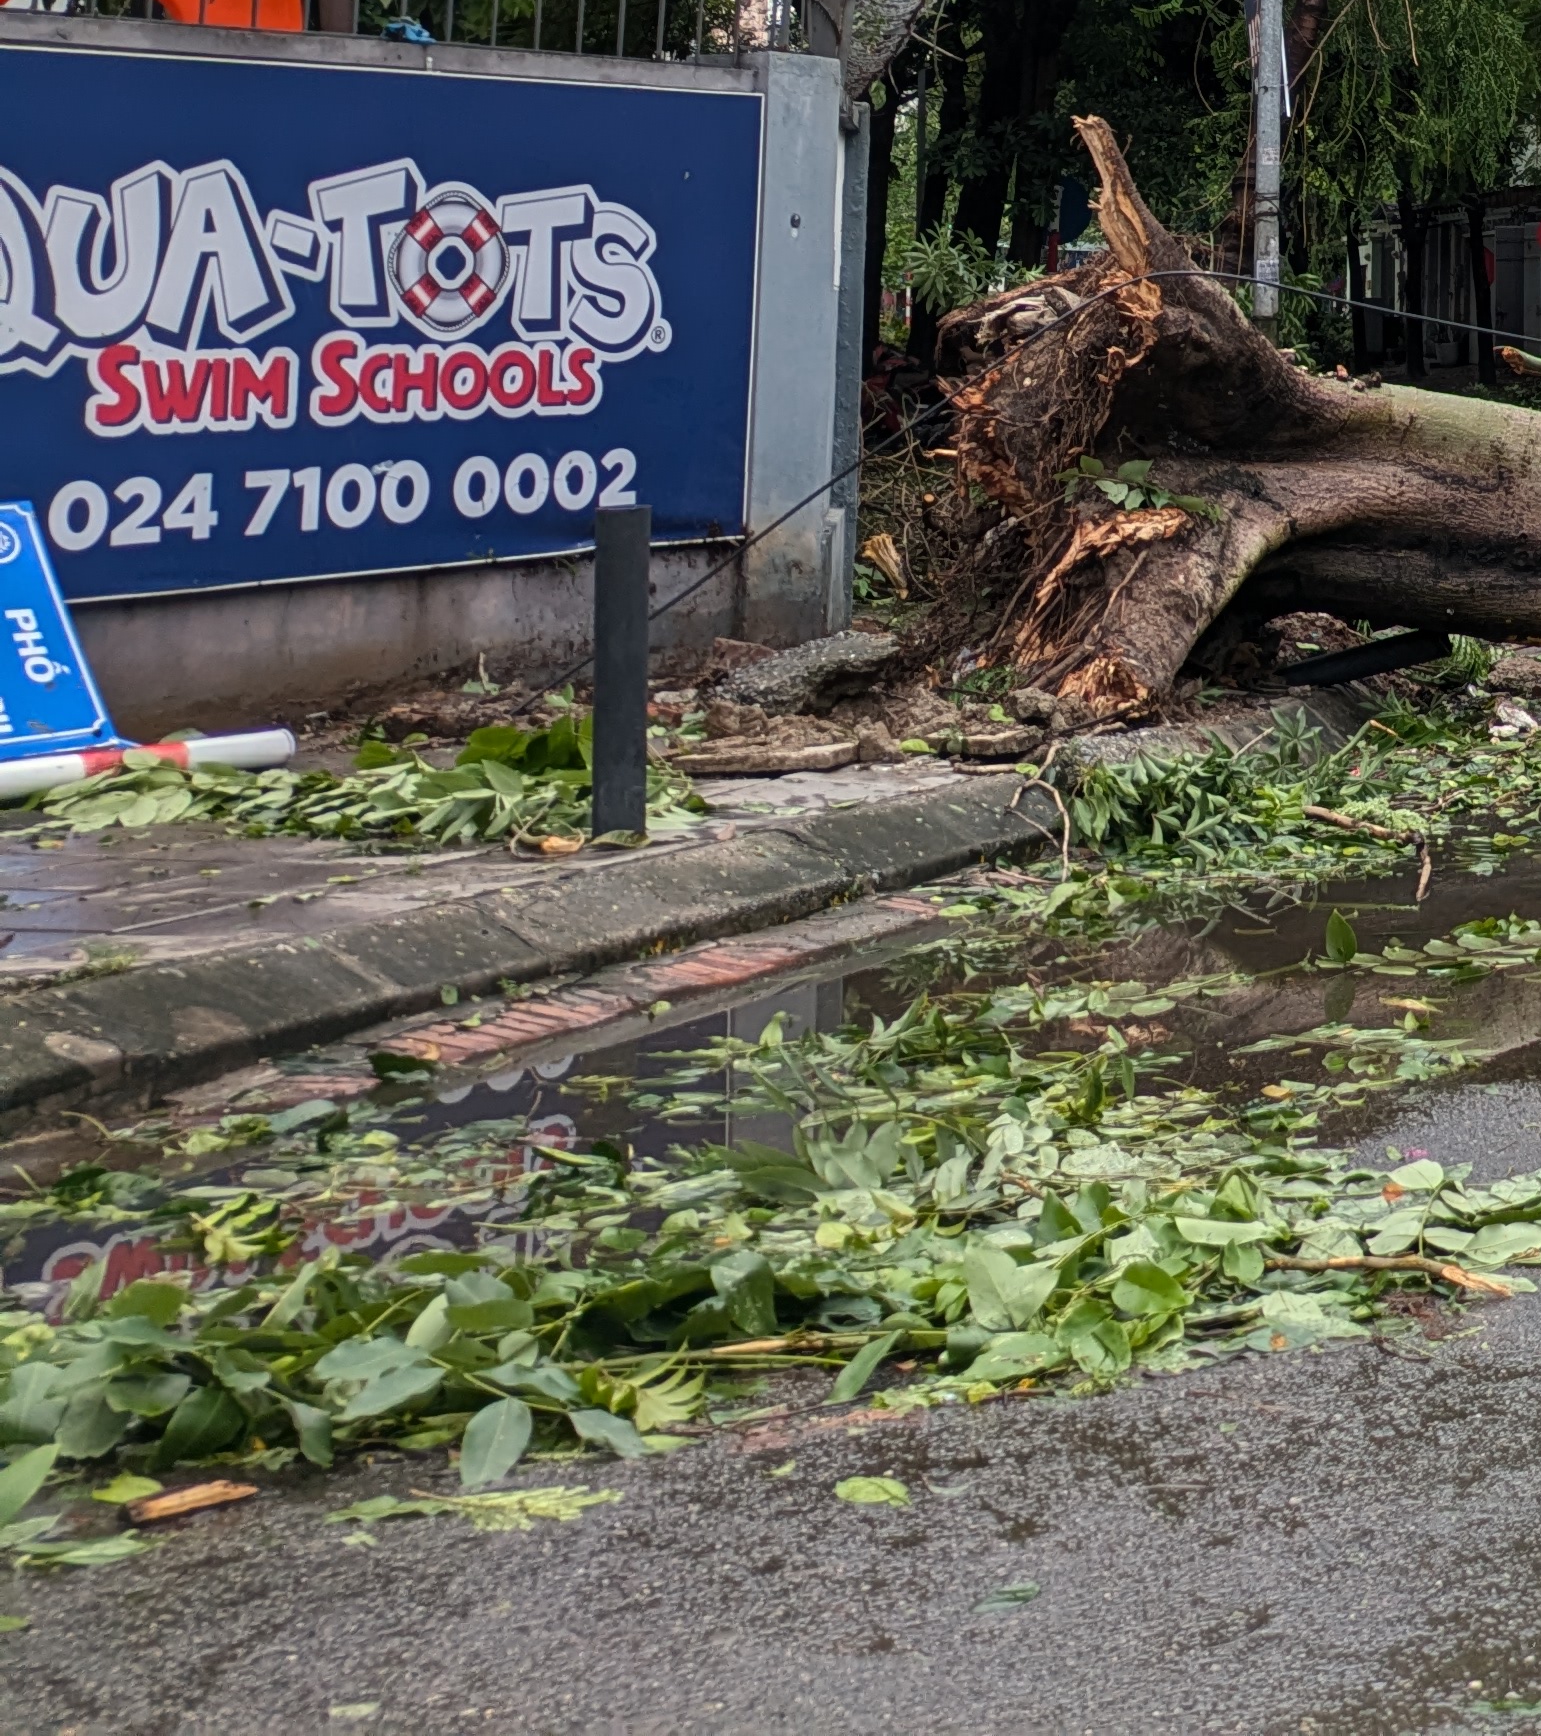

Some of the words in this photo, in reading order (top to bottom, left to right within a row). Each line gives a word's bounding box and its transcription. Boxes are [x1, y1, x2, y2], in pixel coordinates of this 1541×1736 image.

[94, 343, 291, 428] SWIM
[318, 339, 599, 418] SCHOOLS
[48, 473, 219, 552] 024
[243, 458, 431, 538] 7100
[451, 447, 639, 520] 0002
[4, 607, 72, 685] PHỐ
